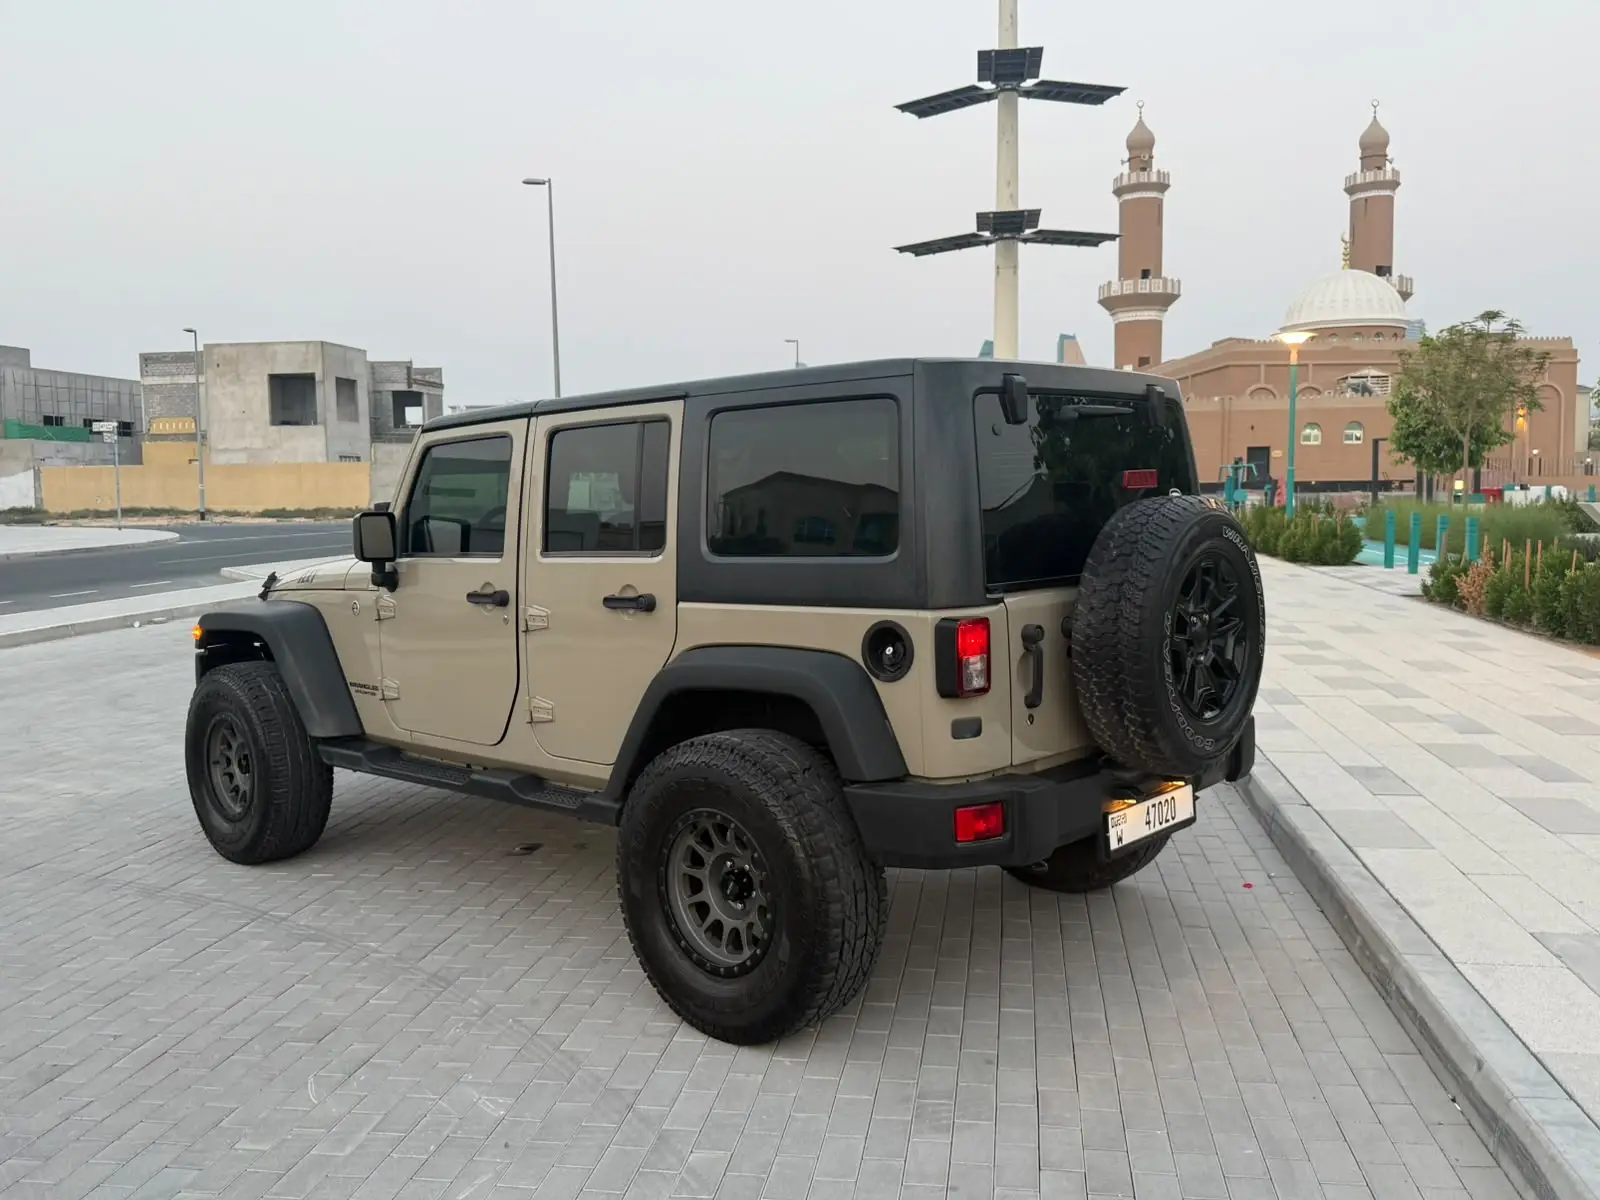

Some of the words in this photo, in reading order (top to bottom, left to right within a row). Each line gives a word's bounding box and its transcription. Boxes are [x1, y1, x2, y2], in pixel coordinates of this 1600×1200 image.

[1163, 611, 1215, 751] GOODYEAR
[1144, 795, 1176, 831] 47020
[1116, 828, 1124, 846] W
